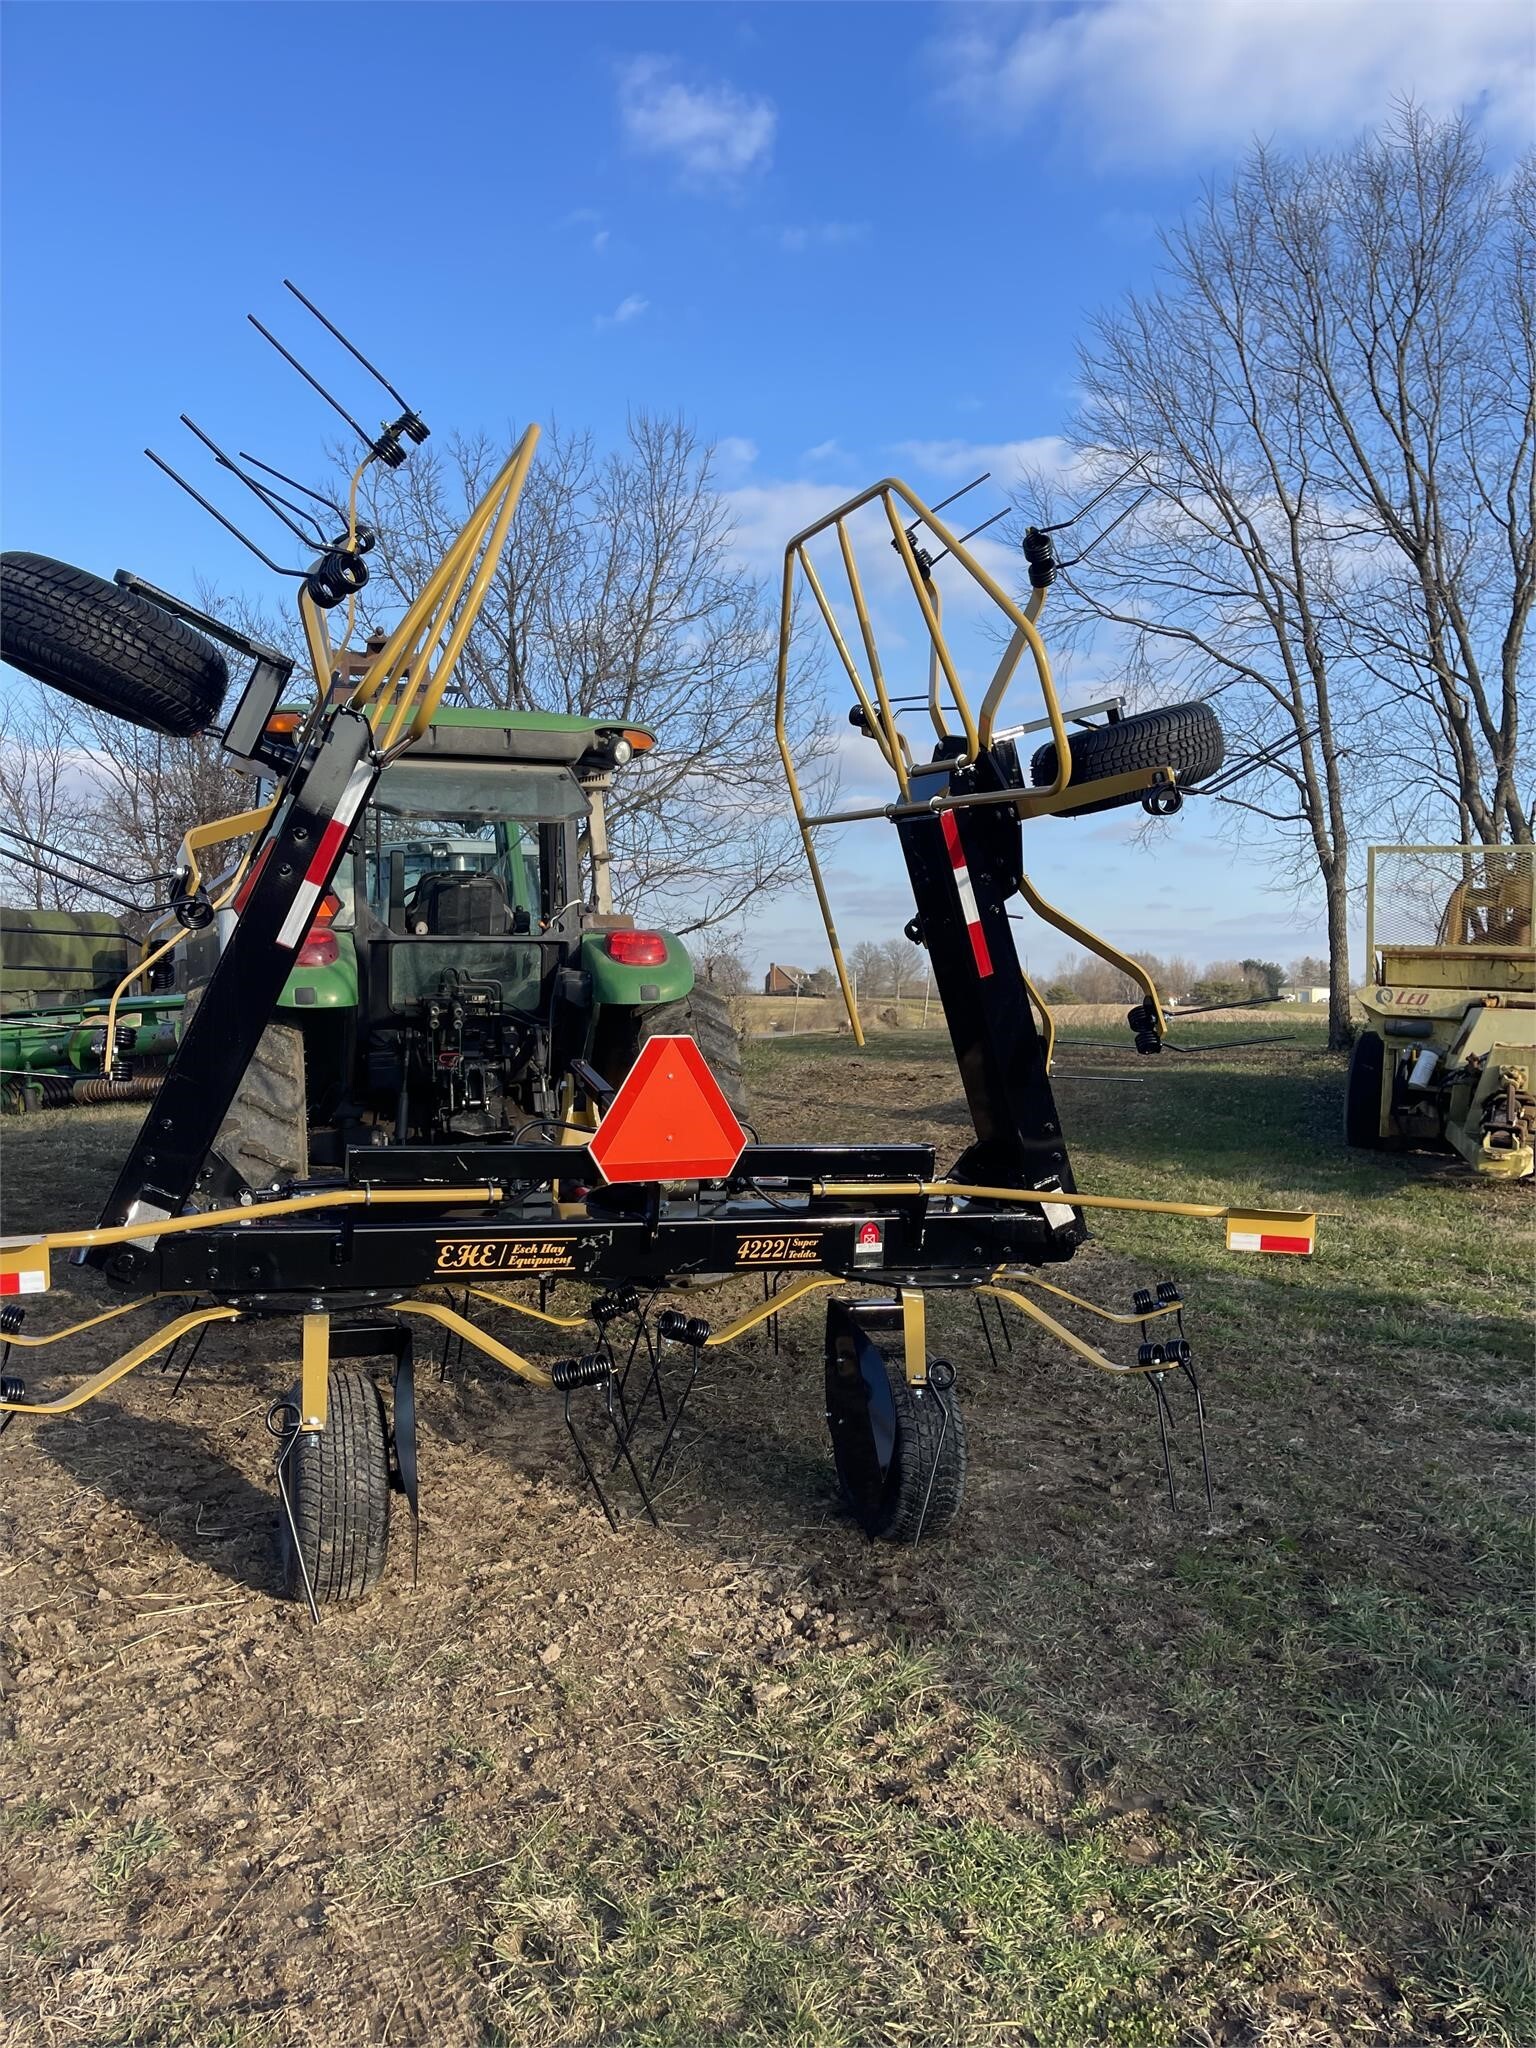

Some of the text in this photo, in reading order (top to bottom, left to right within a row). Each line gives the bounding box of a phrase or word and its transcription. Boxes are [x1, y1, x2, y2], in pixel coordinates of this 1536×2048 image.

[511, 1243, 566, 1256] Esch Hay
[737, 1239, 785, 1259] 4222
[792, 1237, 819, 1249] Super
[437, 1244, 497, 1268] EHE
[788, 1250, 817, 1259] Tedder
[507, 1255, 573, 1268] Equipment
